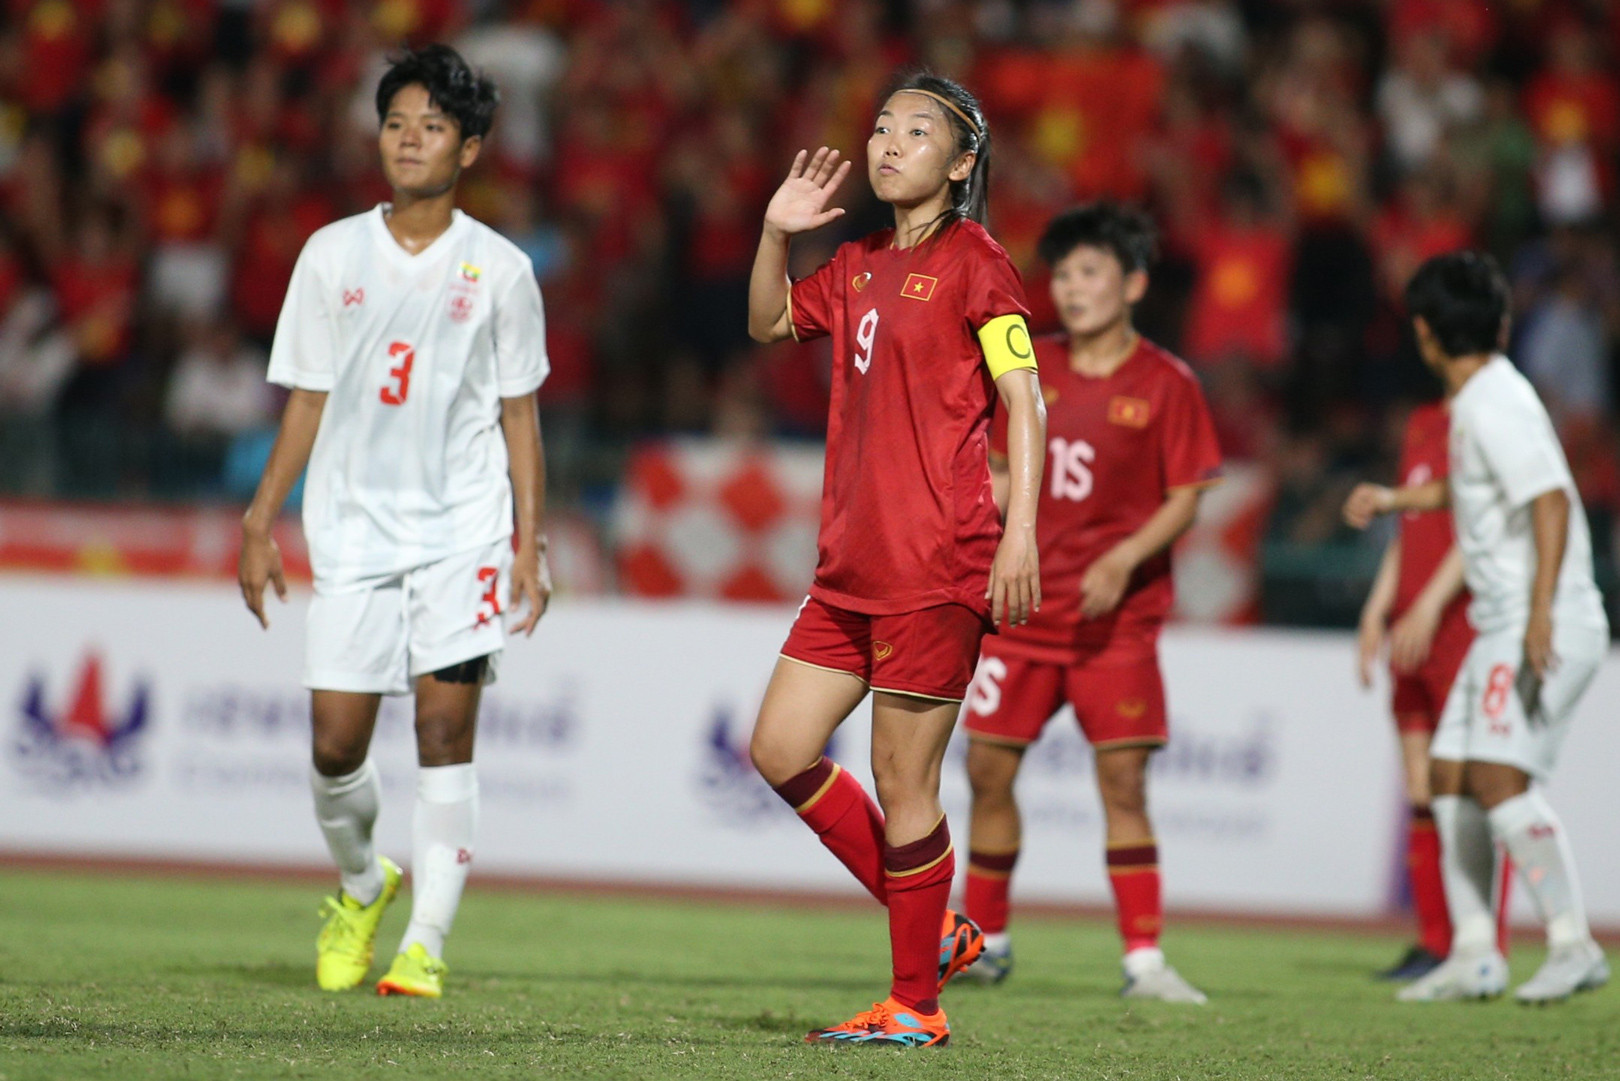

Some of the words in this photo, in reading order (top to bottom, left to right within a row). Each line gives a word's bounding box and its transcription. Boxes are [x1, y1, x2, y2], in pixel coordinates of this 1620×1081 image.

[379, 341, 414, 405] 3
[855, 308, 879, 375] 9
[1006, 324, 1032, 359] C
[1049, 437, 1095, 502] 15
[475, 566, 501, 628] 3
[1482, 663, 1515, 719] 8
